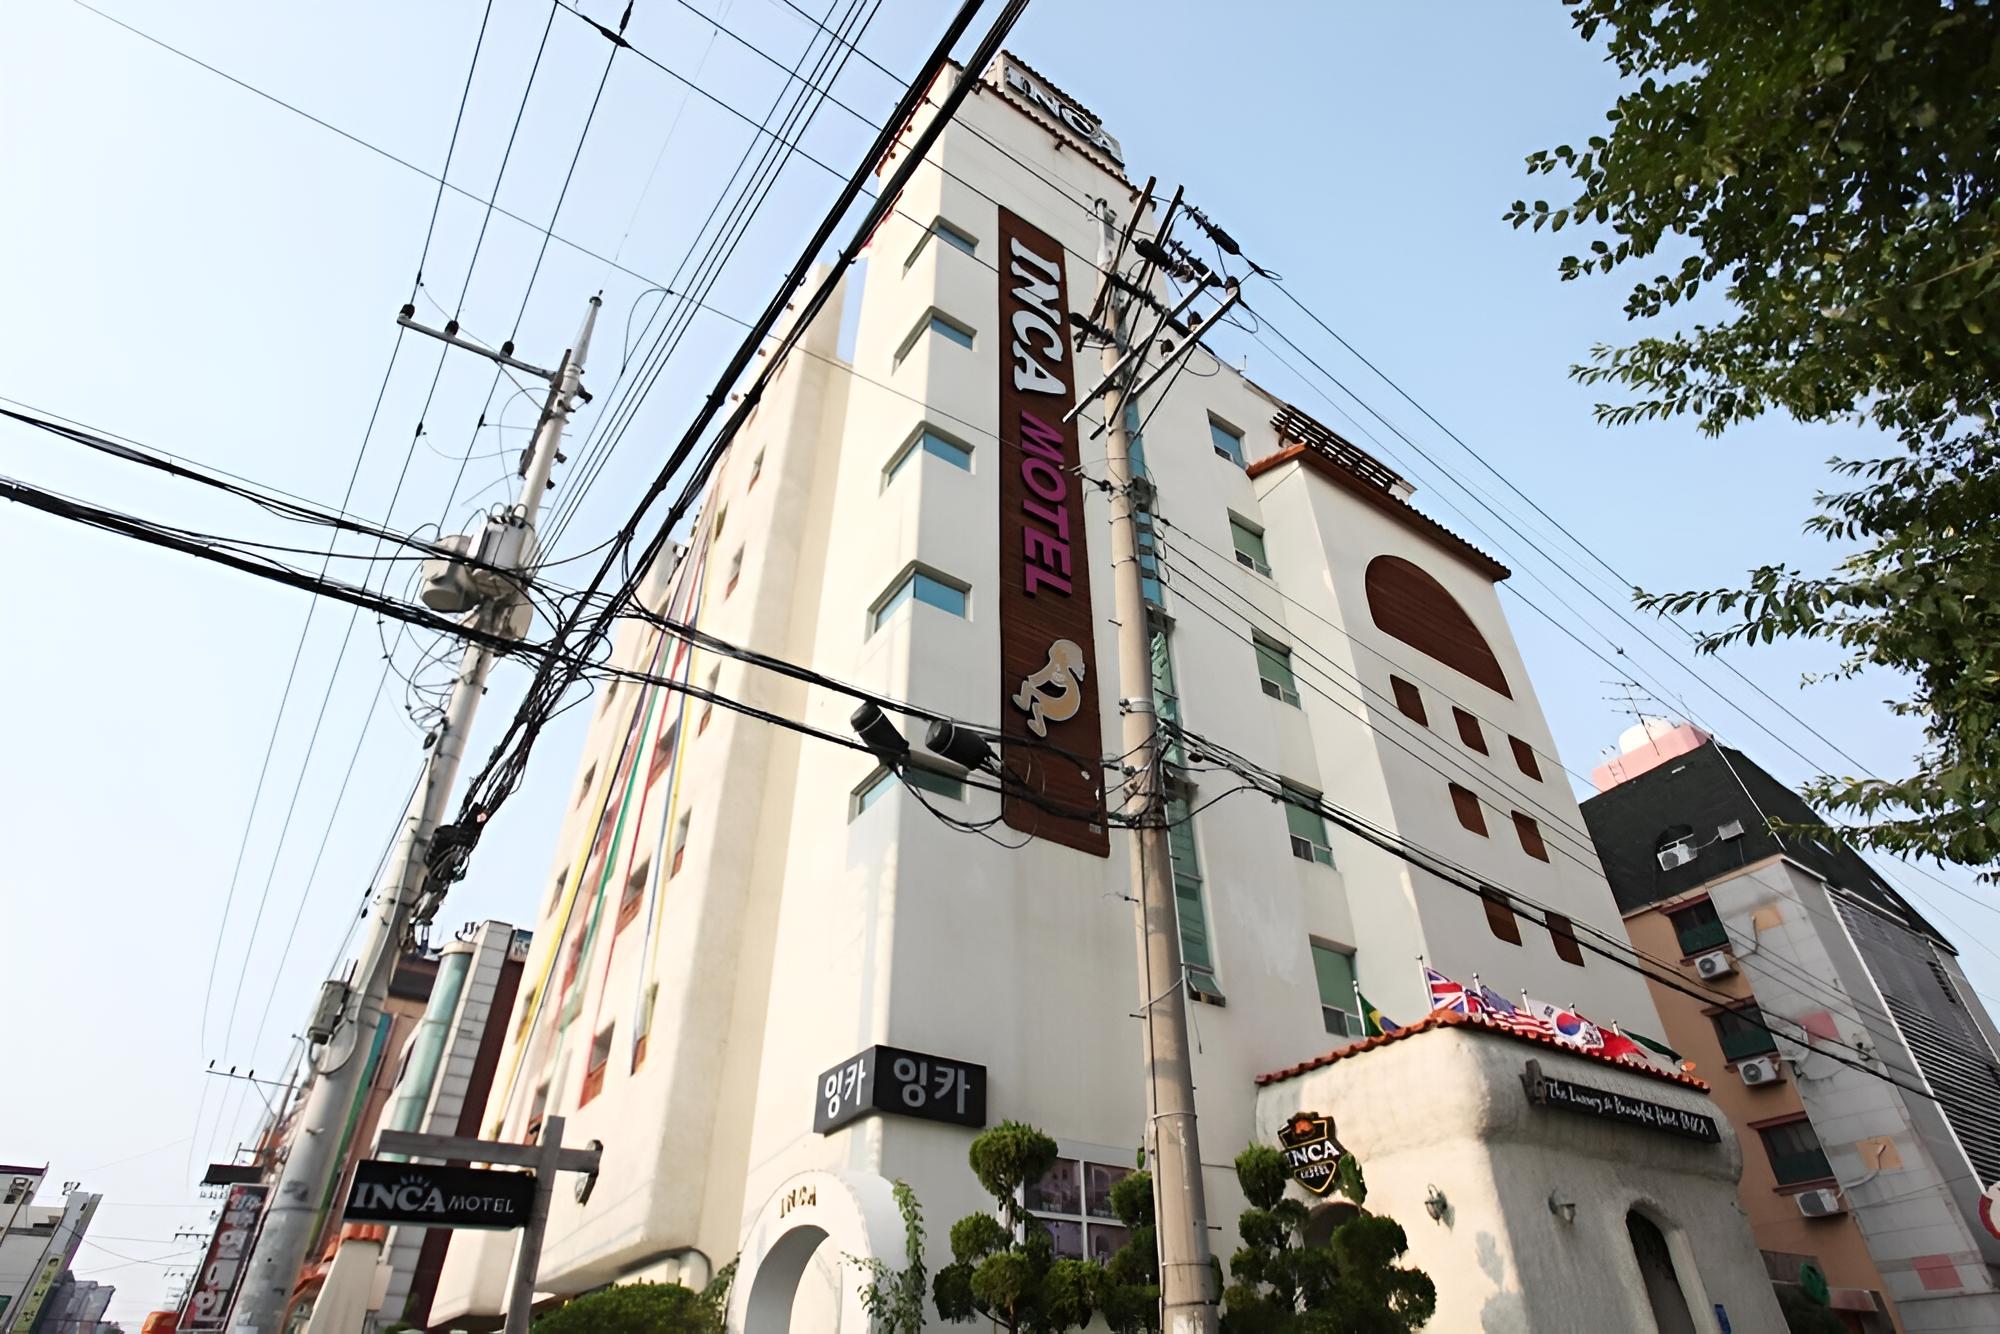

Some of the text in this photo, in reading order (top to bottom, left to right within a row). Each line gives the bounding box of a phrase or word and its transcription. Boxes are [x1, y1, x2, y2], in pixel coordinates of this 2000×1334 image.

[1011, 237, 1072, 597] INCA MOTEL
[824, 1058, 866, 1119] 잉카
[893, 1057, 971, 1114] 잉카
[1285, 1140, 1340, 1168] INCA
[352, 1182, 515, 1213] INCA MOTEL
[780, 1184, 816, 1219] INCA
